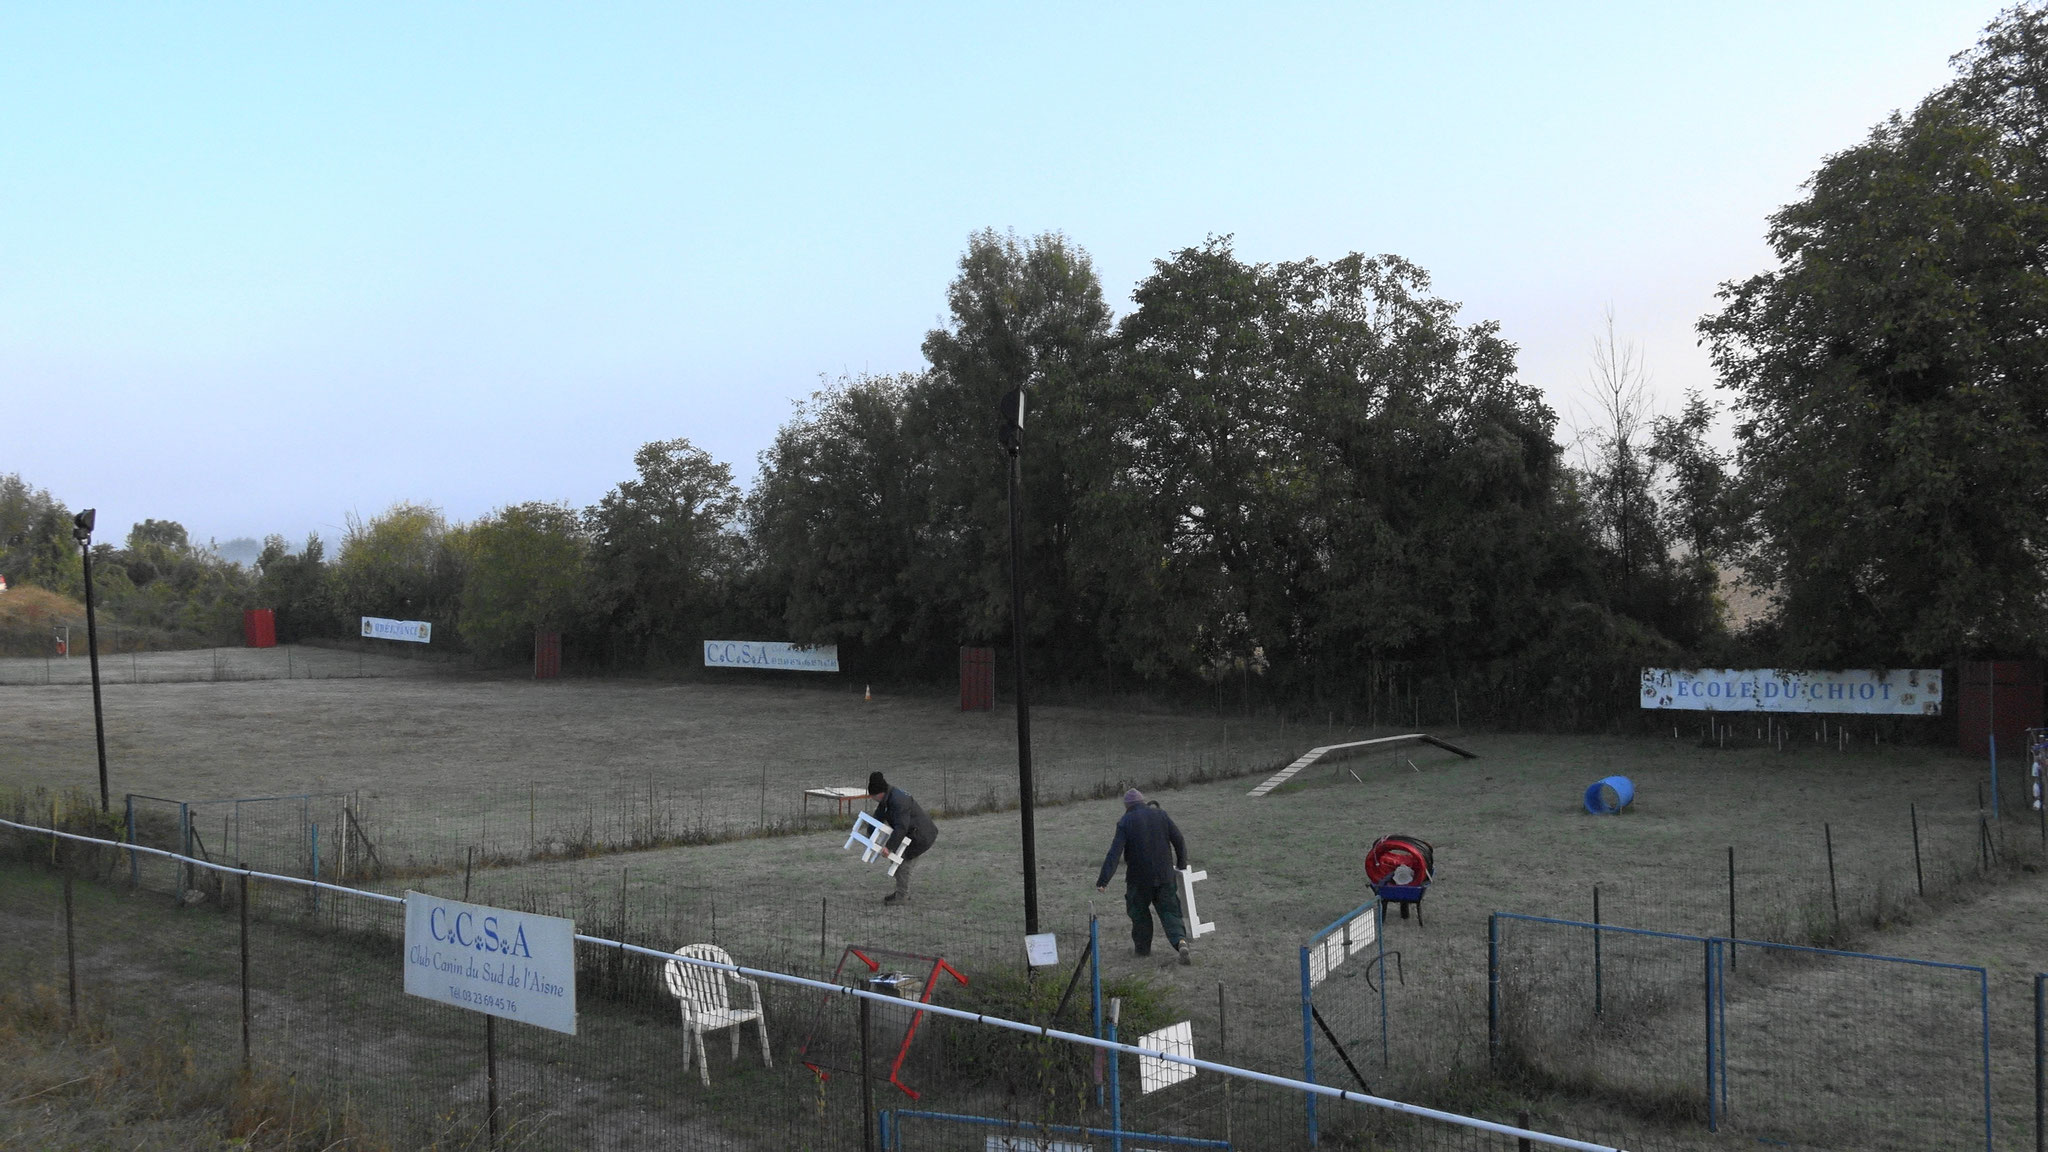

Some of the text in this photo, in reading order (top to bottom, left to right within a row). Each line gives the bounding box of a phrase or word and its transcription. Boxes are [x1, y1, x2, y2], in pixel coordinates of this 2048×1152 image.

[1677, 680, 1894, 700] ECOLE DU CHIOT
[410, 944, 565, 998] Club Canin du Sud de l'Aisne
[463, 989, 472, 1002] 03
[473, 992, 482, 1005] 23
[484, 994, 494, 1007] 69
[495, 998, 505, 1010] 45
[507, 1000, 517, 1013] 76
